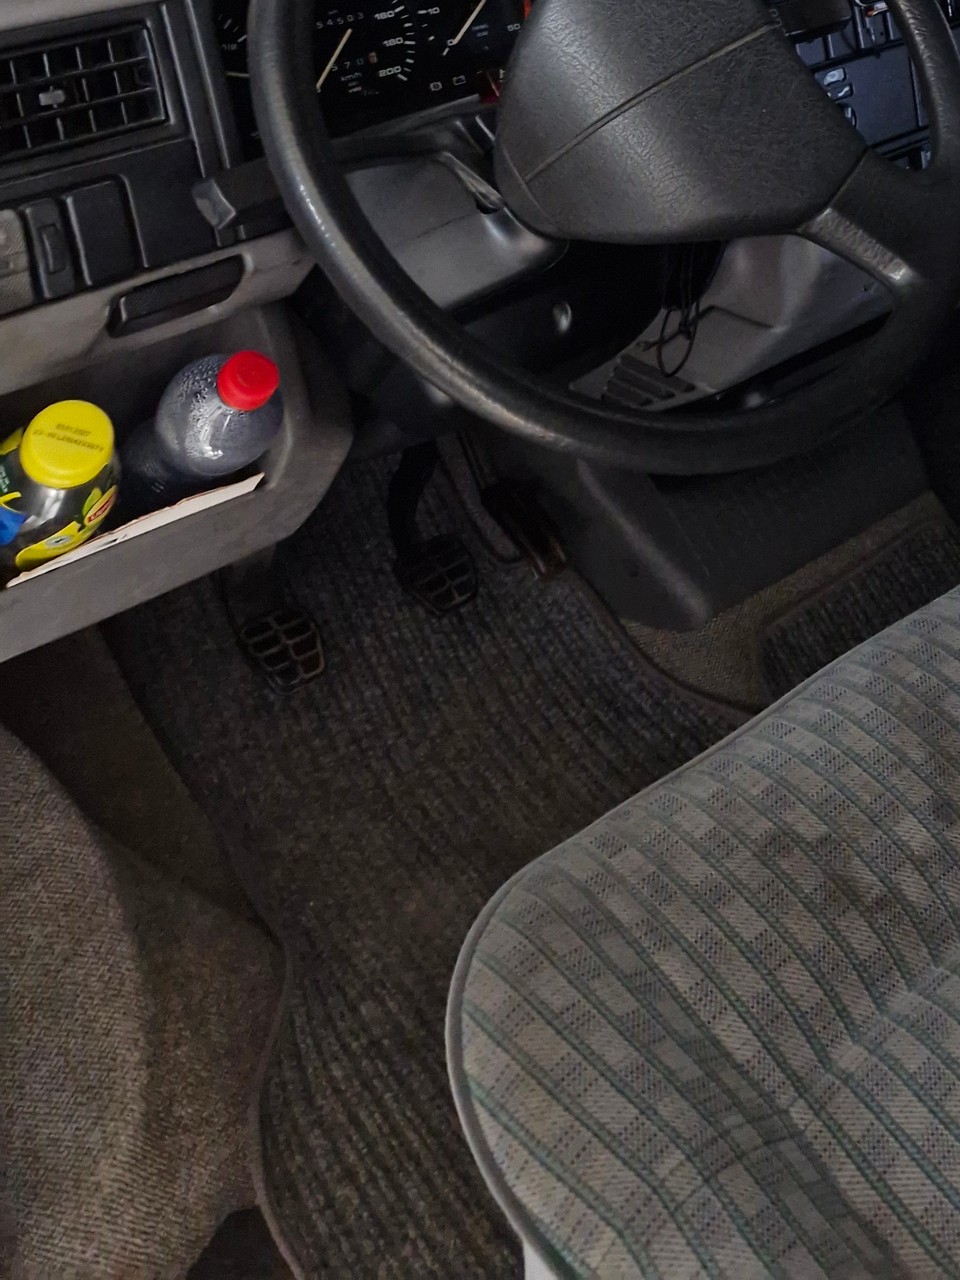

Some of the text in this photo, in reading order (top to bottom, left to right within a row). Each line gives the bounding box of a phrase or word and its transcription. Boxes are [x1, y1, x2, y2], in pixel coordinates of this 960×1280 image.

[374, 10, 395, 20] 160
[427, 6, 441, 16] 10
[507, 23, 521, 32] 50
[382, 36, 404, 48] 180
[378, 65, 402, 78] 200
